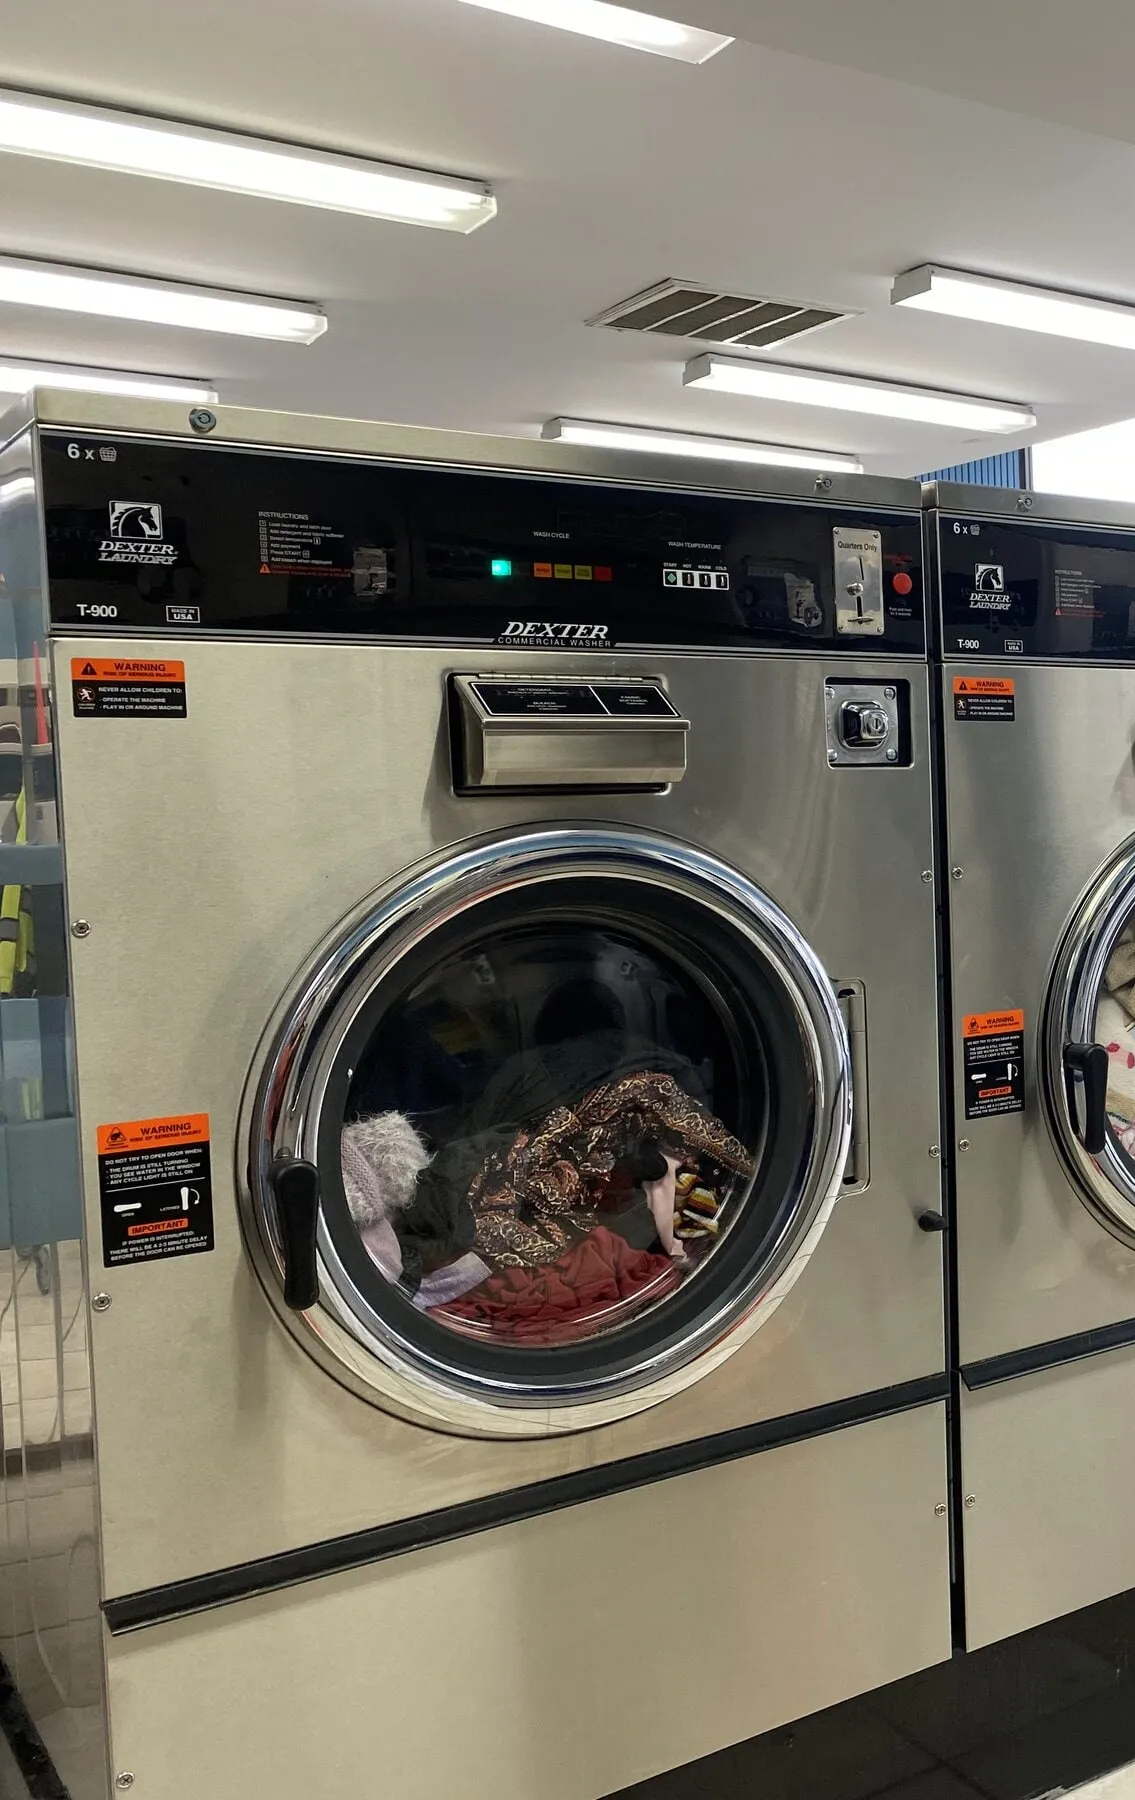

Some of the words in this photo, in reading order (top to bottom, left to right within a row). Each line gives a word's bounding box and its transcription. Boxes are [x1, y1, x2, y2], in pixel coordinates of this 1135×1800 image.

[67, 443, 80, 459] 6
[84, 449, 95, 460] x
[258, 511, 309, 520] INSTRUCTIONS
[953, 522, 960, 534] 6
[98, 540, 175, 555] DEXTER
[684, 541, 722, 550] TEMPERATURE
[837, 541, 863, 550] Quarters
[864, 543, 877, 552] Only
[98, 552, 178, 565] LAUNDRY
[969, 593, 1010, 603] DEXTER
[76, 604, 118, 617] T-900
[969, 601, 1011, 610] LAUNDRY
[173, 613, 193, 621] USA
[501, 621, 609, 640] DEXTER
[497, 636, 566, 646] COMMERCIAL
[569, 638, 612, 647] WASHER
[957, 639, 980, 649] T-900
[114, 663, 166, 672] WARNING
[976, 680, 1005, 688] WARNING
[986, 1015, 1015, 1025] WARNING
[140, 1122, 191, 1136] WARNING
[146, 1161, 163, 1169] STILL
[163, 1158, 189, 1167] TURNING
[176, 1162, 201, 1170] WINDOW
[123, 1176, 142, 1184] CYCLE
[143, 1173, 160, 1181] LIGHT
[131, 1220, 184, 1234] IMPORTANT
[109, 1248, 129, 1256] THERE
[167, 1239, 189, 1247] MINUTE
[189, 1235, 208, 1243] DELAY
[128, 1237, 149, 1245] POWER
[110, 1253, 134, 1261] BEFORE
[146, 1248, 163, 1256] DOOR
[184, 1241, 207, 1250] OPENED
